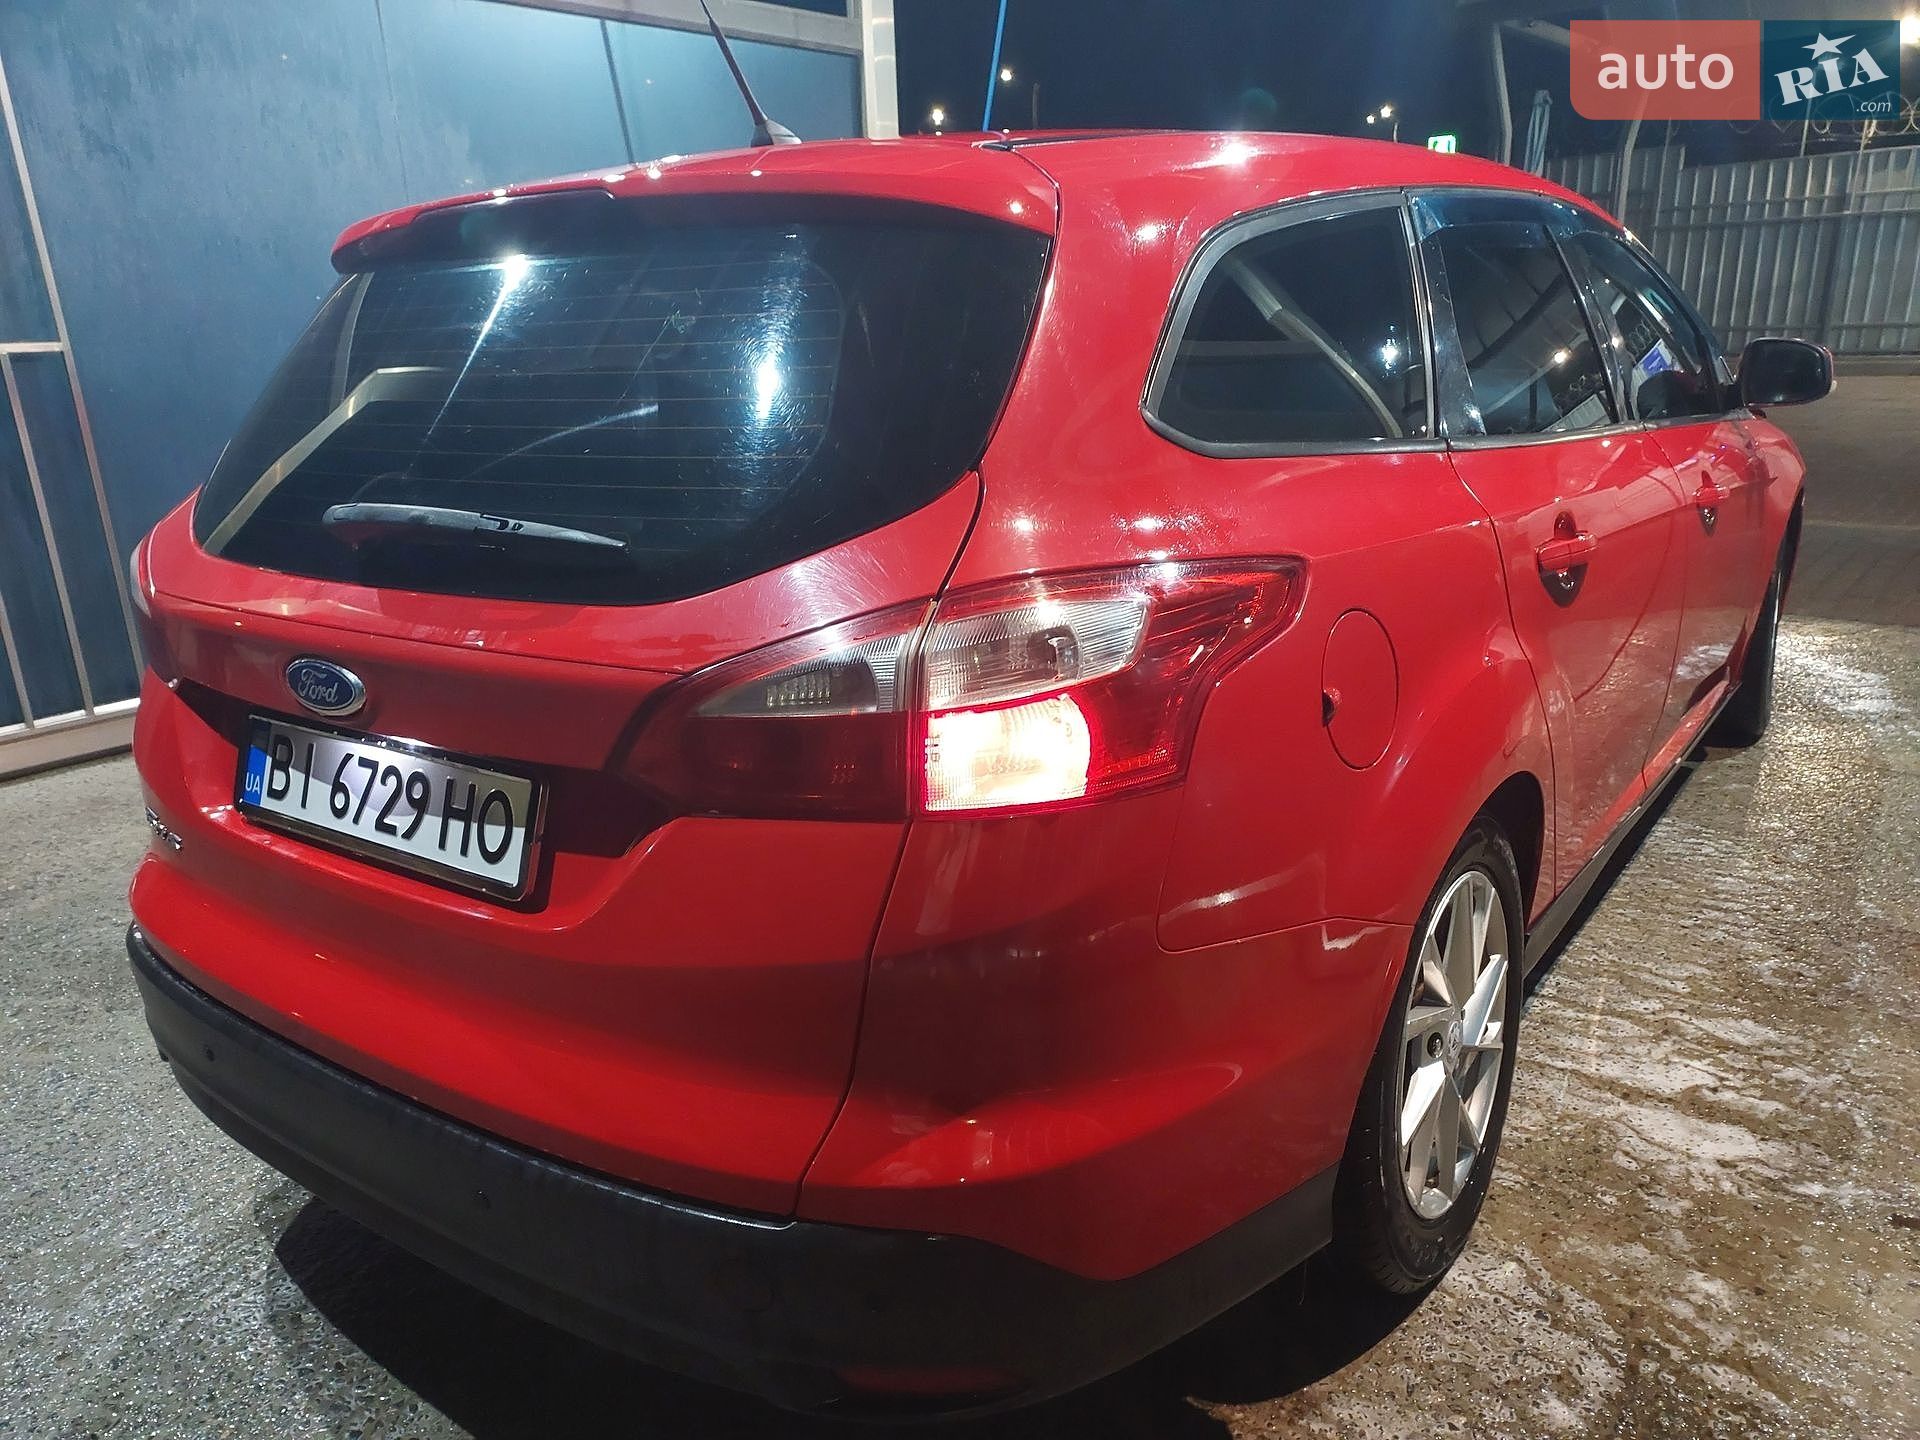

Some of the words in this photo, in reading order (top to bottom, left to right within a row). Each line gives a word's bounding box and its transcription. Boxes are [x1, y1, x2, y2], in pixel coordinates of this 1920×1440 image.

[298, 668, 339, 703] Ford
[245, 771, 261, 795] UA
[266, 733, 315, 810] BI
[329, 752, 431, 841] 6729
[437, 775, 515, 866] HO
